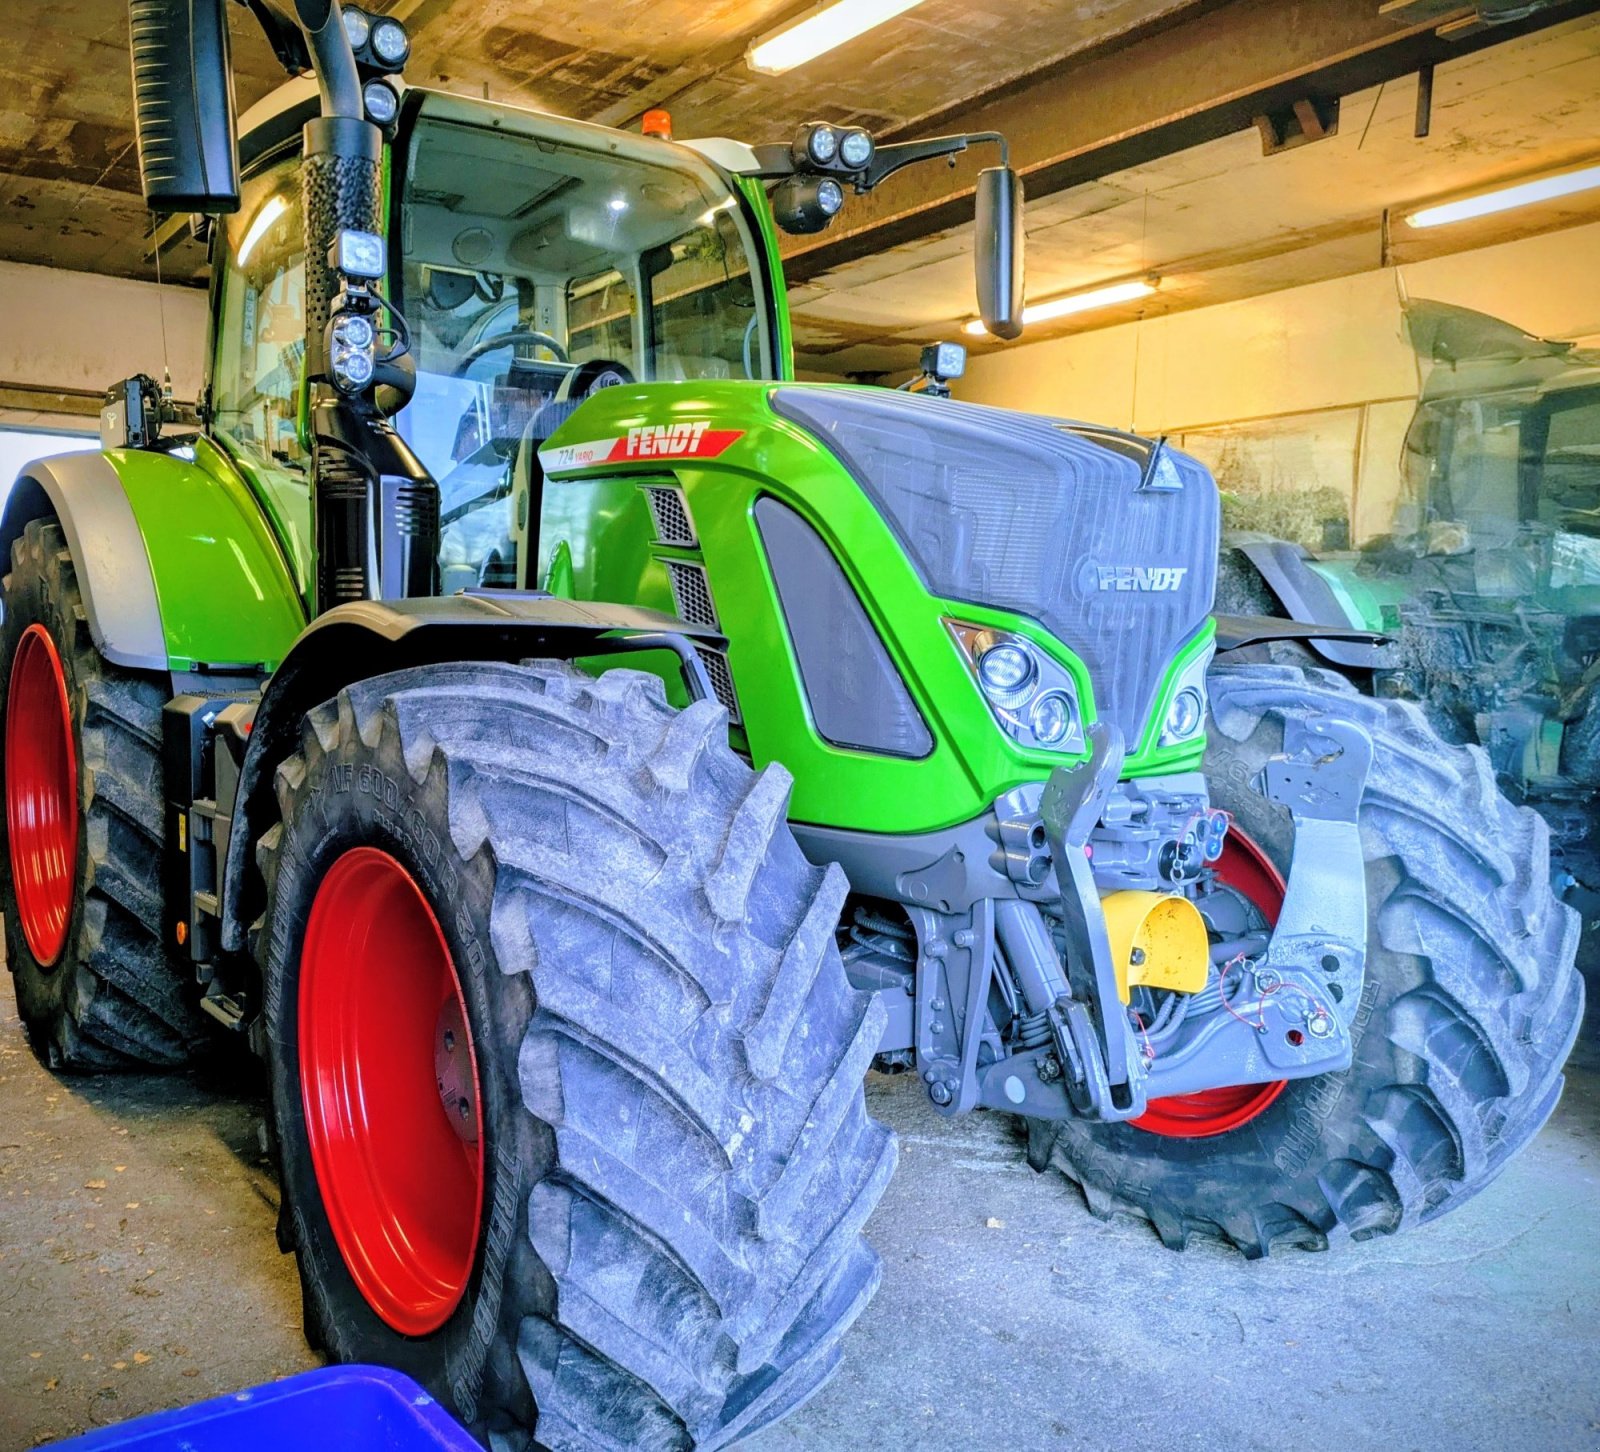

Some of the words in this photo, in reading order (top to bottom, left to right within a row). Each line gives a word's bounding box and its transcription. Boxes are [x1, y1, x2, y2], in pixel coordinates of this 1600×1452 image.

[626, 420, 713, 456] FENDT
[558, 448, 575, 466] 724
[575, 450, 594, 464] VARIO
[1097, 566, 1188, 591] FENDT
[331, 762, 353, 793] VF
[1273, 979, 1381, 1178] TREBORG
[453, 1145, 523, 1422] TRELLEBORG
